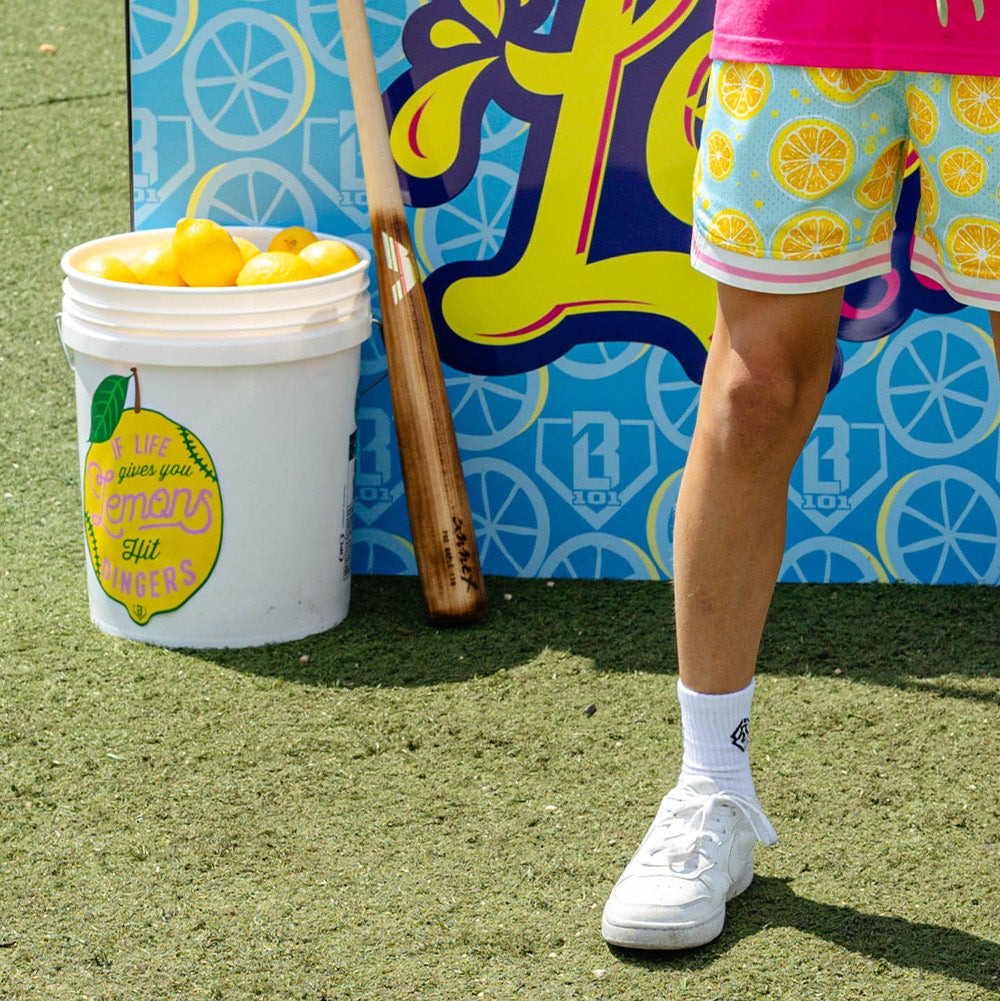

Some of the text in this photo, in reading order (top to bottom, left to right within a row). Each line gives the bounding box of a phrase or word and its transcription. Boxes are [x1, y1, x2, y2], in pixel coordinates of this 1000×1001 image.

[111, 435, 172, 460] IF LIFE
[117, 463, 194, 484] gives you
[88, 461, 216, 540] Lemons
[572, 491, 620, 506] 101
[802, 495, 851, 510] 101
[122, 538, 162, 564] Hit
[101, 558, 197, 598] DINGERS
